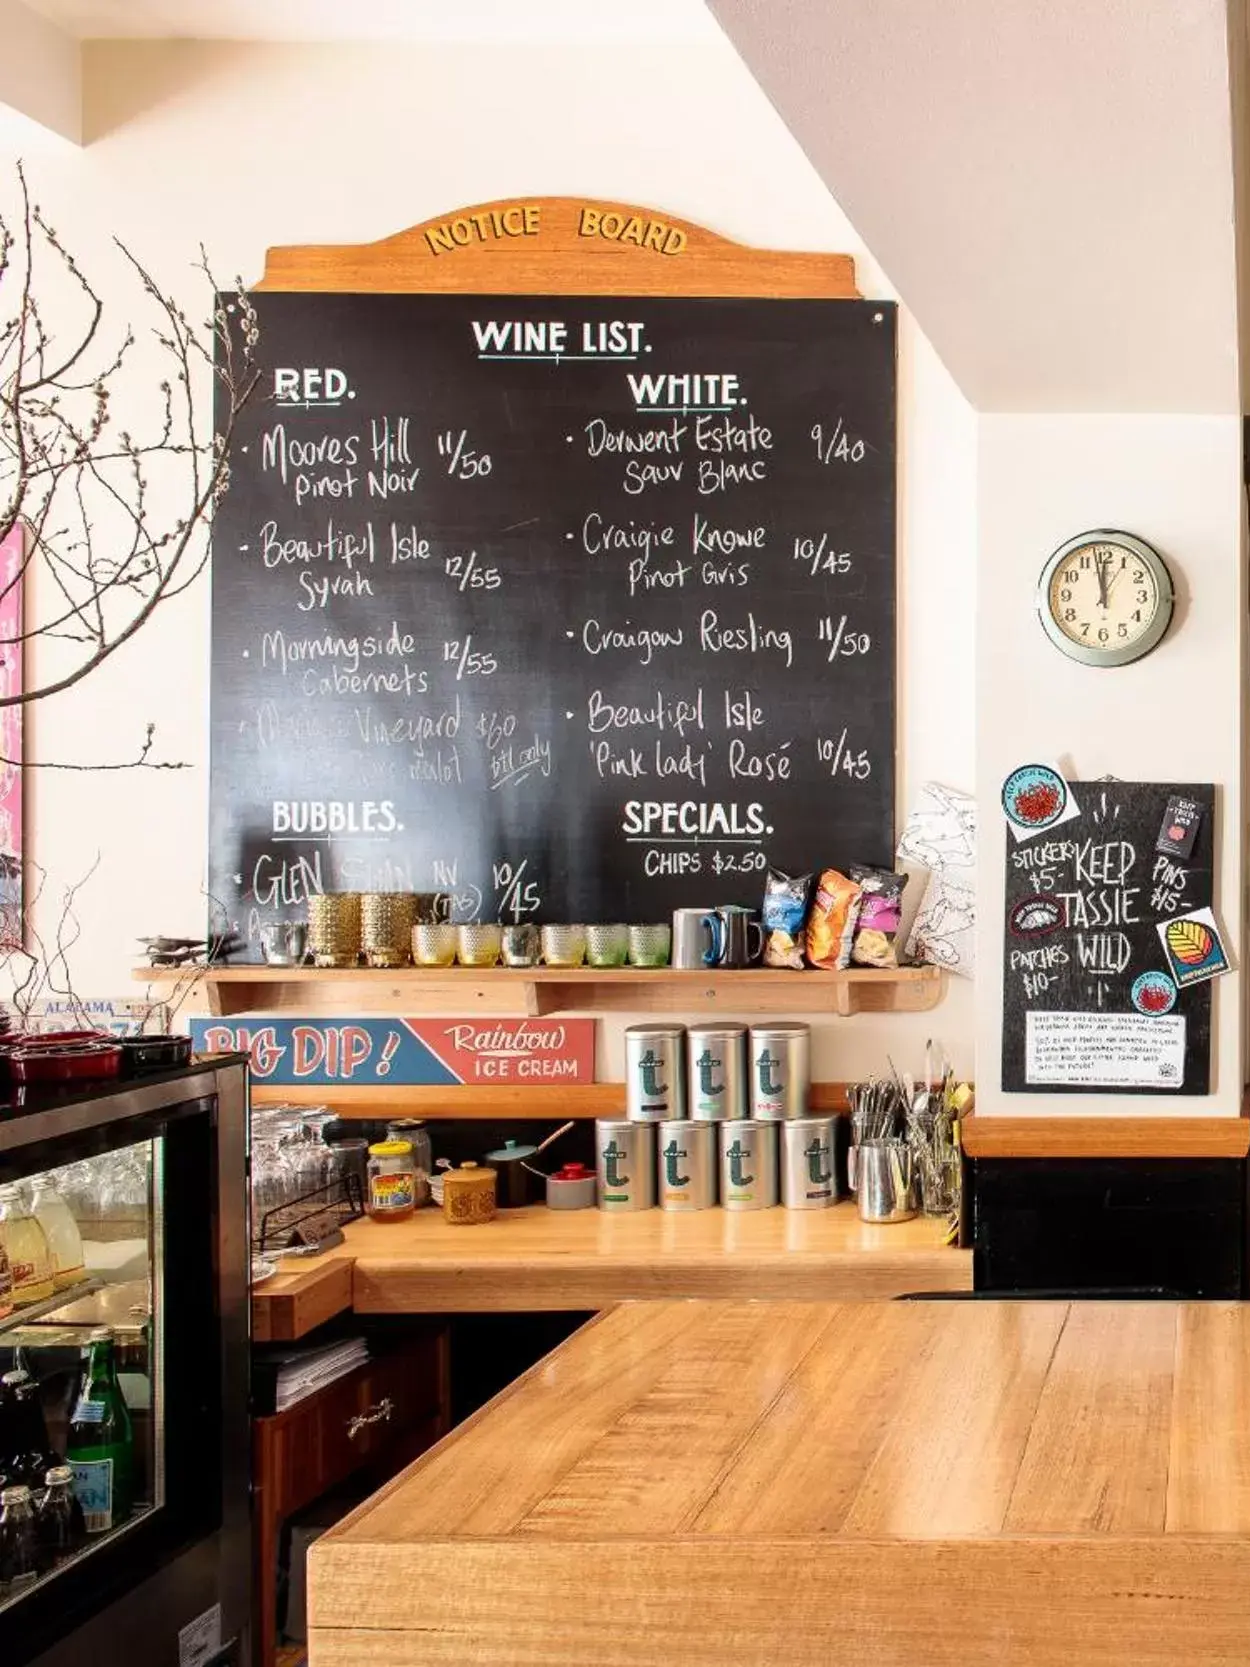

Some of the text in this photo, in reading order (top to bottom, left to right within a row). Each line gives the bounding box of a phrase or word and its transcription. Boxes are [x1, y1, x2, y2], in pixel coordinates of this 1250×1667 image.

[424, 206, 688, 256] NOTICE BOARD
[471, 320, 652, 353] WINE LIST.
[274, 367, 356, 402] RED.
[626, 373, 748, 406] WHITE.
[261, 423, 361, 486] Moores
[371, 415, 412, 470] Hill
[584, 413, 866, 465] Derwent Estate 9/40
[367, 468, 420, 500] Noir
[697, 458, 767, 495] Blanc
[259, 517, 431, 570] Beautiful Isle
[582, 512, 675, 563] Craigie
[793, 532, 852, 576] 10/45
[1097, 551, 1114, 565] 12
[701, 562, 750, 587] Gris
[1064, 569, 1079, 583] 10
[1080, 556, 1090, 569] 11
[1120, 556, 1127, 569] 1
[1133, 571, 1145, 584] 2
[297, 550, 502, 612] Syrah 12/55
[1060, 589, 1073, 603] 9
[1137, 590, 1149, 604] 3
[1064, 608, 1077, 621] 8
[1080, 623, 1090, 636] 7
[1117, 623, 1128, 638] 5
[1131, 609, 1141, 622] 4
[261, 620, 498, 681] Morningside 12/55
[700, 609, 793, 668] Riesling
[818, 614, 872, 663] 11/50
[1098, 628, 1110, 642] 6
[586, 687, 766, 737] Beautiful Isle
[729, 738, 795, 782] Rosé
[817, 727, 871, 781] 10/45
[272, 800, 405, 833] BUBBLES.
[622, 800, 775, 836] SPECIALS.
[644, 849, 767, 878] CHIPS $2.50
[1010, 839, 1077, 870] STICKERS
[1074, 837, 1137, 888] KEEP
[252, 850, 325, 910] GLEN
[492, 858, 542, 924] 10/45
[1152, 856, 1190, 891] PINS
[1055, 887, 1141, 929] TASSIE
[1010, 944, 1071, 971] PATCHES
[1075, 931, 1132, 974] WILD
[44, 1001, 115, 1015] ALABAMA
[443, 1020, 567, 1053] Rainbow
[474, 1057, 579, 1078] ICE CREAM
[638, 1049, 669, 1097] t
[696, 1048, 725, 1097] t
[755, 1048, 786, 1096] t
[603, 1139, 630, 1187] t
[663, 1139, 692, 1187] t
[726, 1139, 754, 1186] t
[803, 1137, 832, 1187] t
